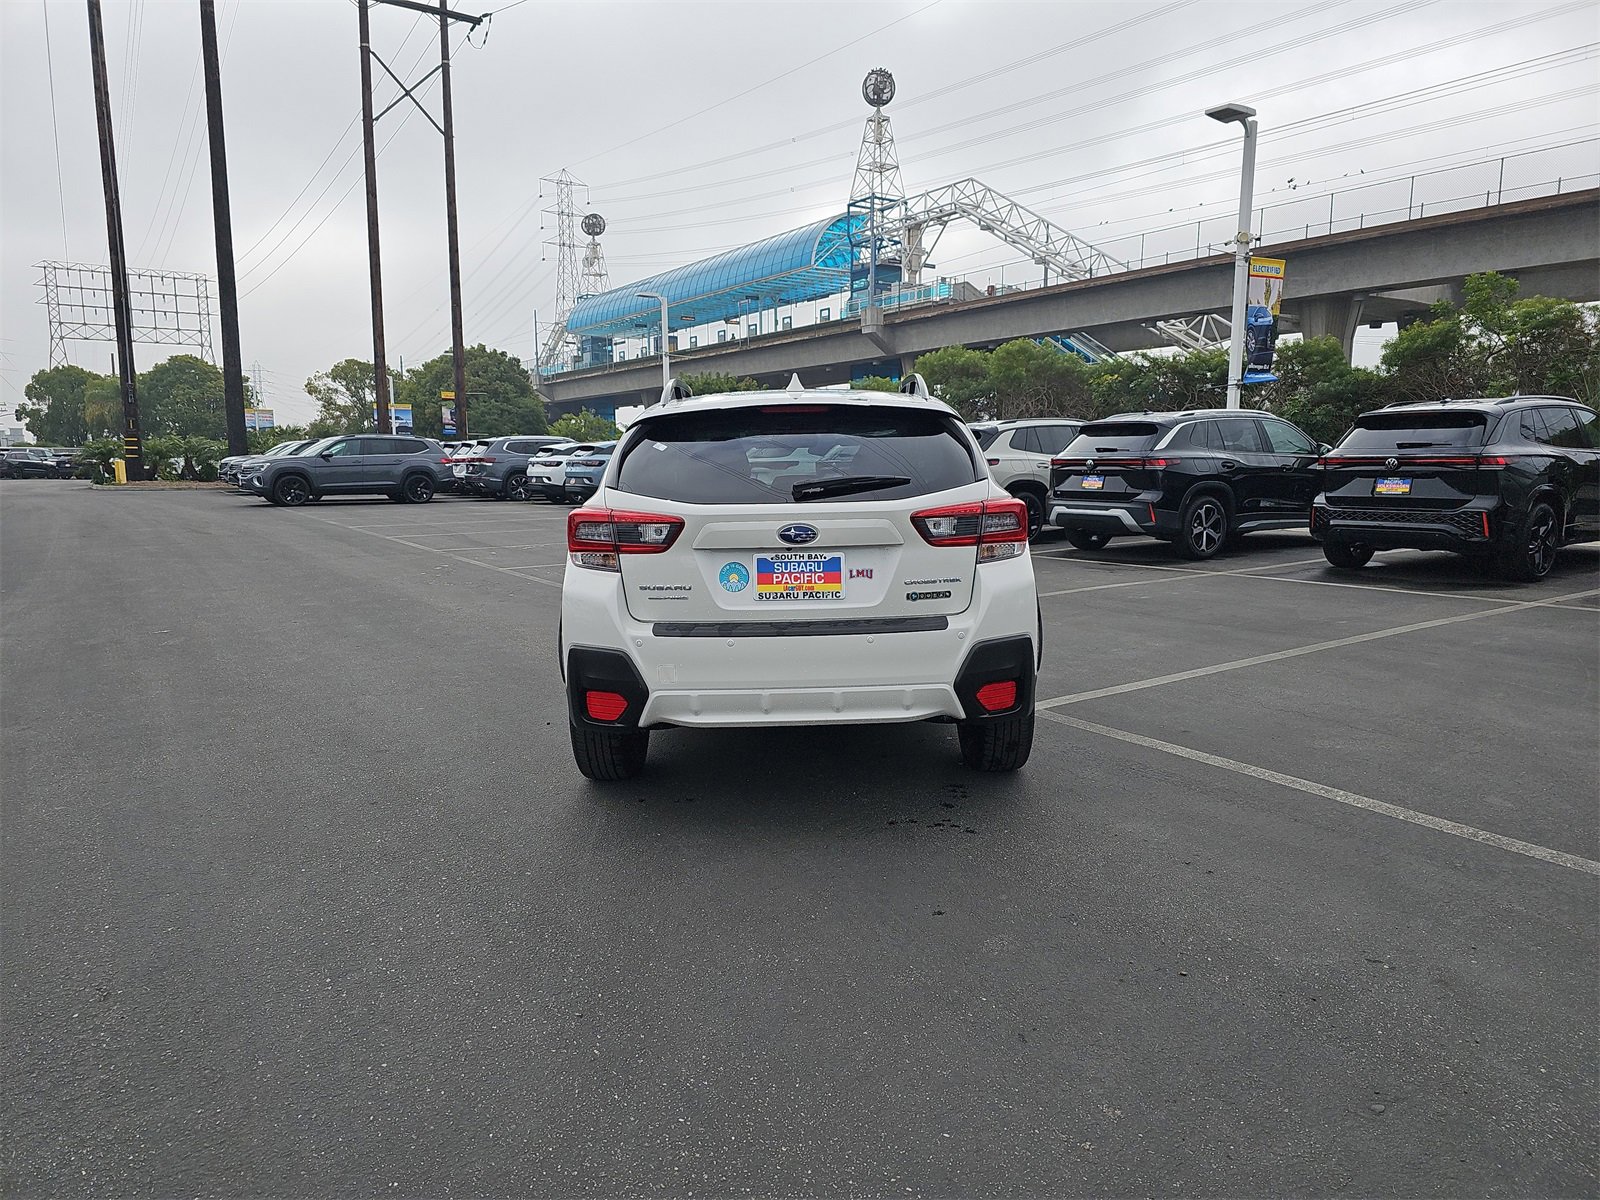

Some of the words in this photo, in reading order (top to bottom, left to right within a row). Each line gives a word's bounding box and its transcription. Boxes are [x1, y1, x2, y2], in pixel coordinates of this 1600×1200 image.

[1252, 264, 1280, 274] ELECTRIFIED
[775, 553, 805, 561] SOUTH
[774, 561, 823, 573] SUBARU
[773, 572, 825, 585] PACIFIC
[849, 568, 874, 579] LMU
[904, 576, 962, 585] CROSSTREK
[758, 591, 799, 600] SUBARU
[802, 590, 841, 599] PACIFIC
